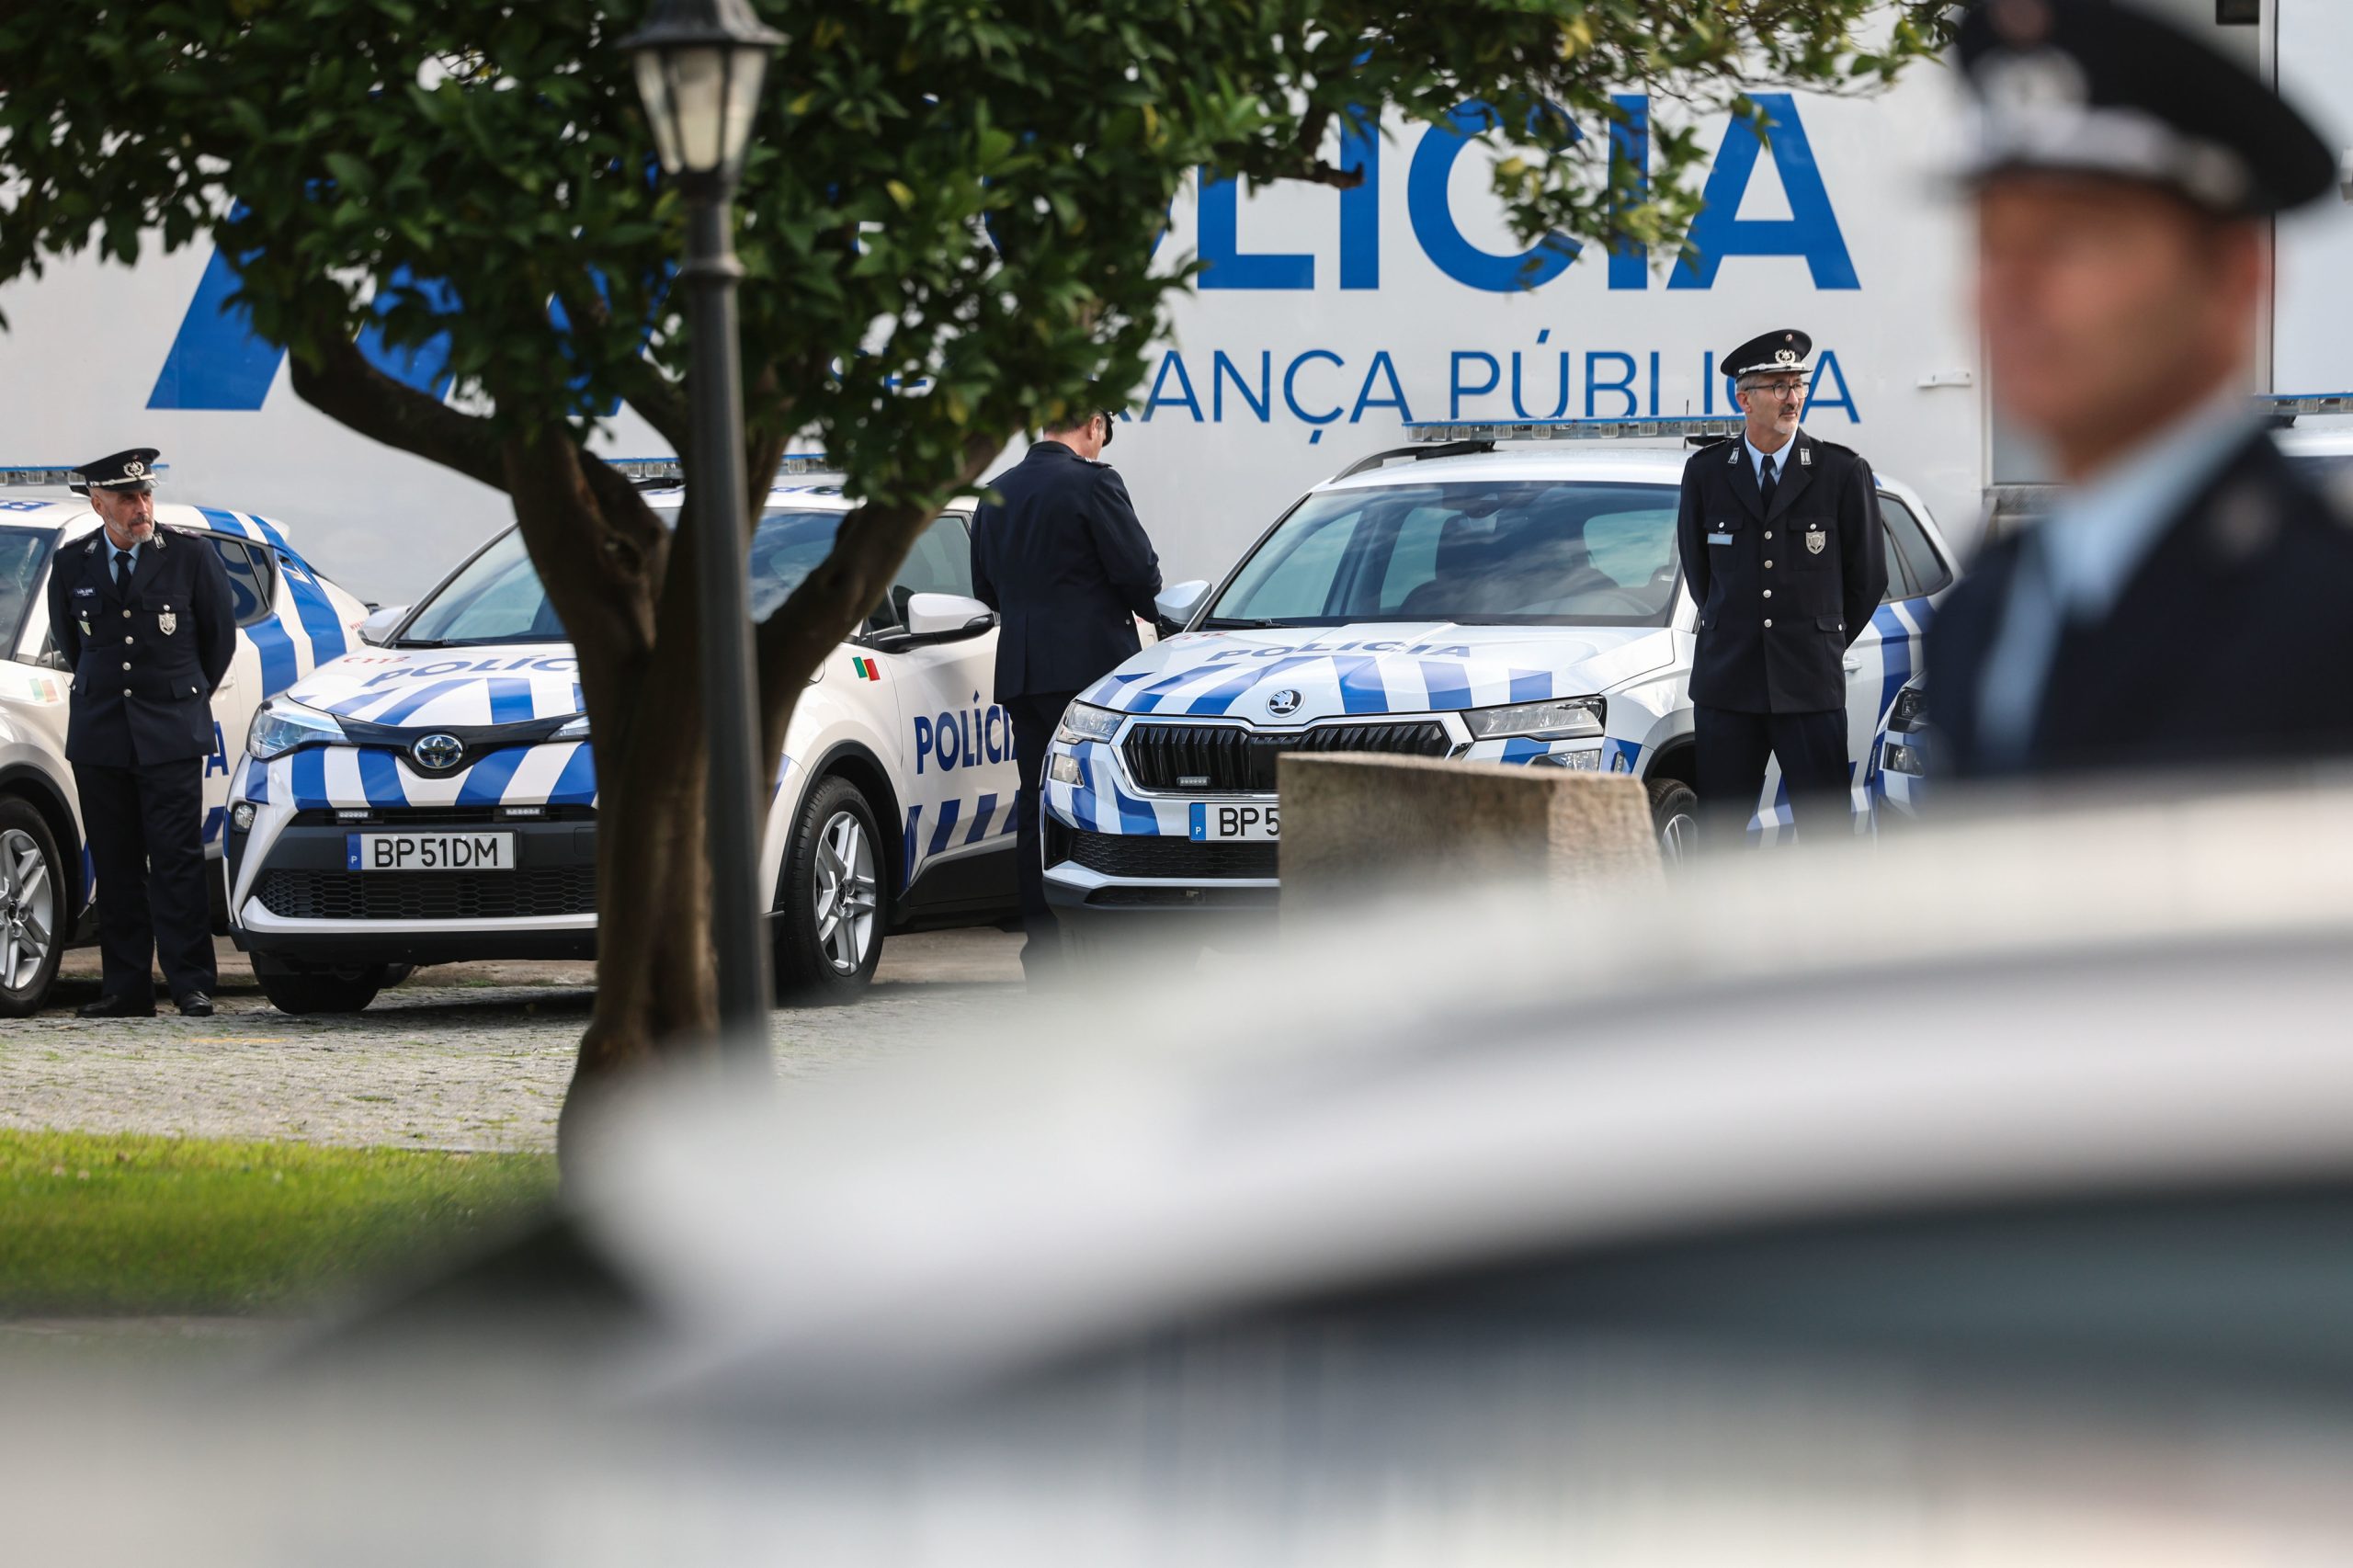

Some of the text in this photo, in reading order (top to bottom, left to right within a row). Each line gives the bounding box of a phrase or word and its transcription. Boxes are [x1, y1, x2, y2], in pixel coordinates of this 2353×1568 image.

[1450, 329, 1861, 424] PÚBLIA
[361, 653, 580, 687] POLÍC
[914, 689, 1017, 775] POLÍCI
